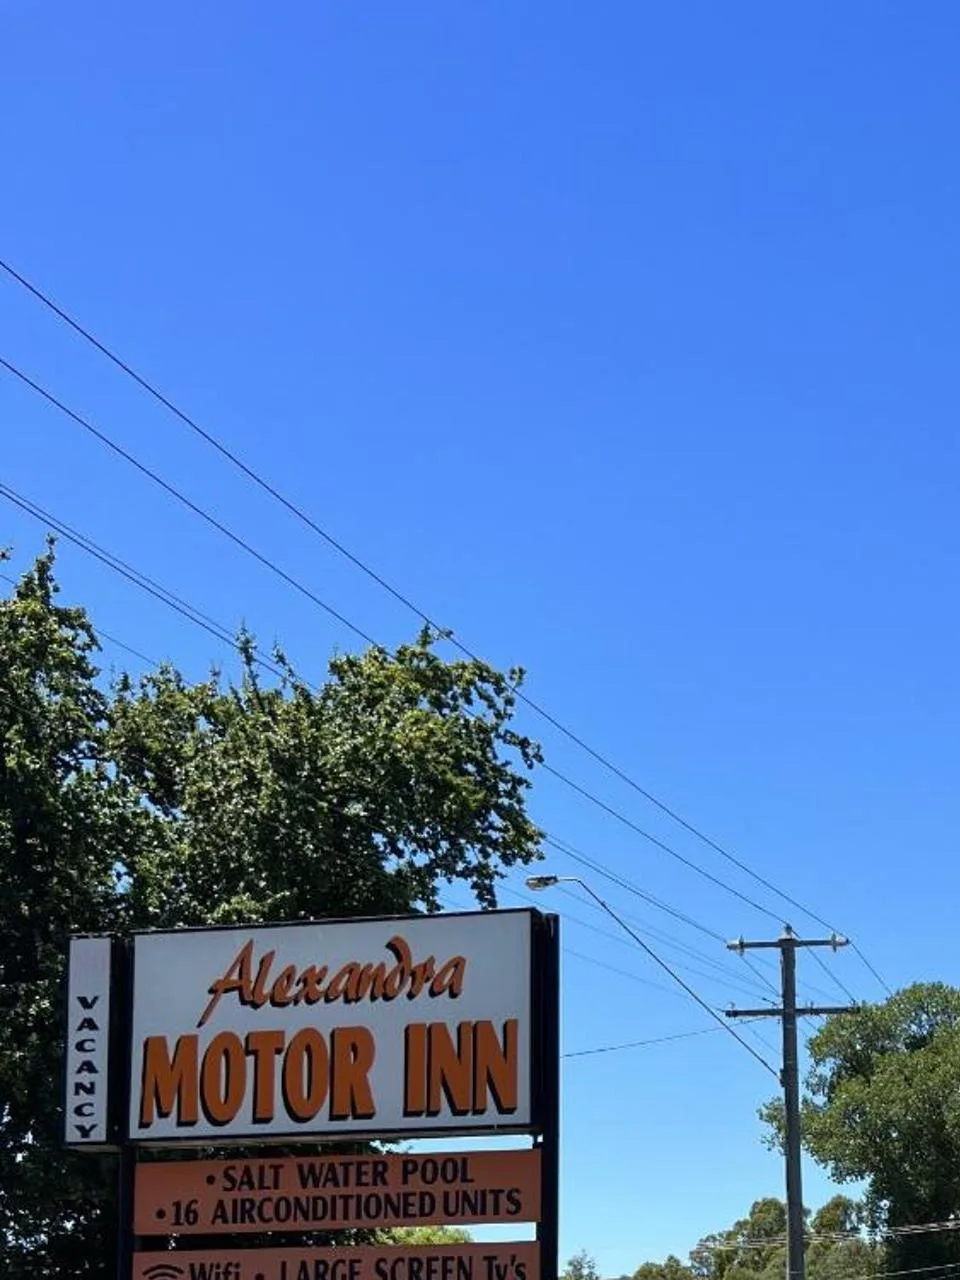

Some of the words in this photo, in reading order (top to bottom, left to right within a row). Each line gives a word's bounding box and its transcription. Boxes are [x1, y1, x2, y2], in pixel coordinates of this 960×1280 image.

[197, 935, 467, 1028] Alexandra
[74, 995, 99, 1141] VACANCY
[138, 1025, 376, 1129] MOTOR
[403, 1018, 518, 1118] INN
[171, 1200, 199, 1226] 16
[211, 1191, 434, 1226] AIRCONDITIONED
[443, 1188, 522, 1218] UNITS
[222, 1163, 285, 1192] SALT
[297, 1164, 388, 1190] WATER
[402, 1157, 475, 1185] POOL
